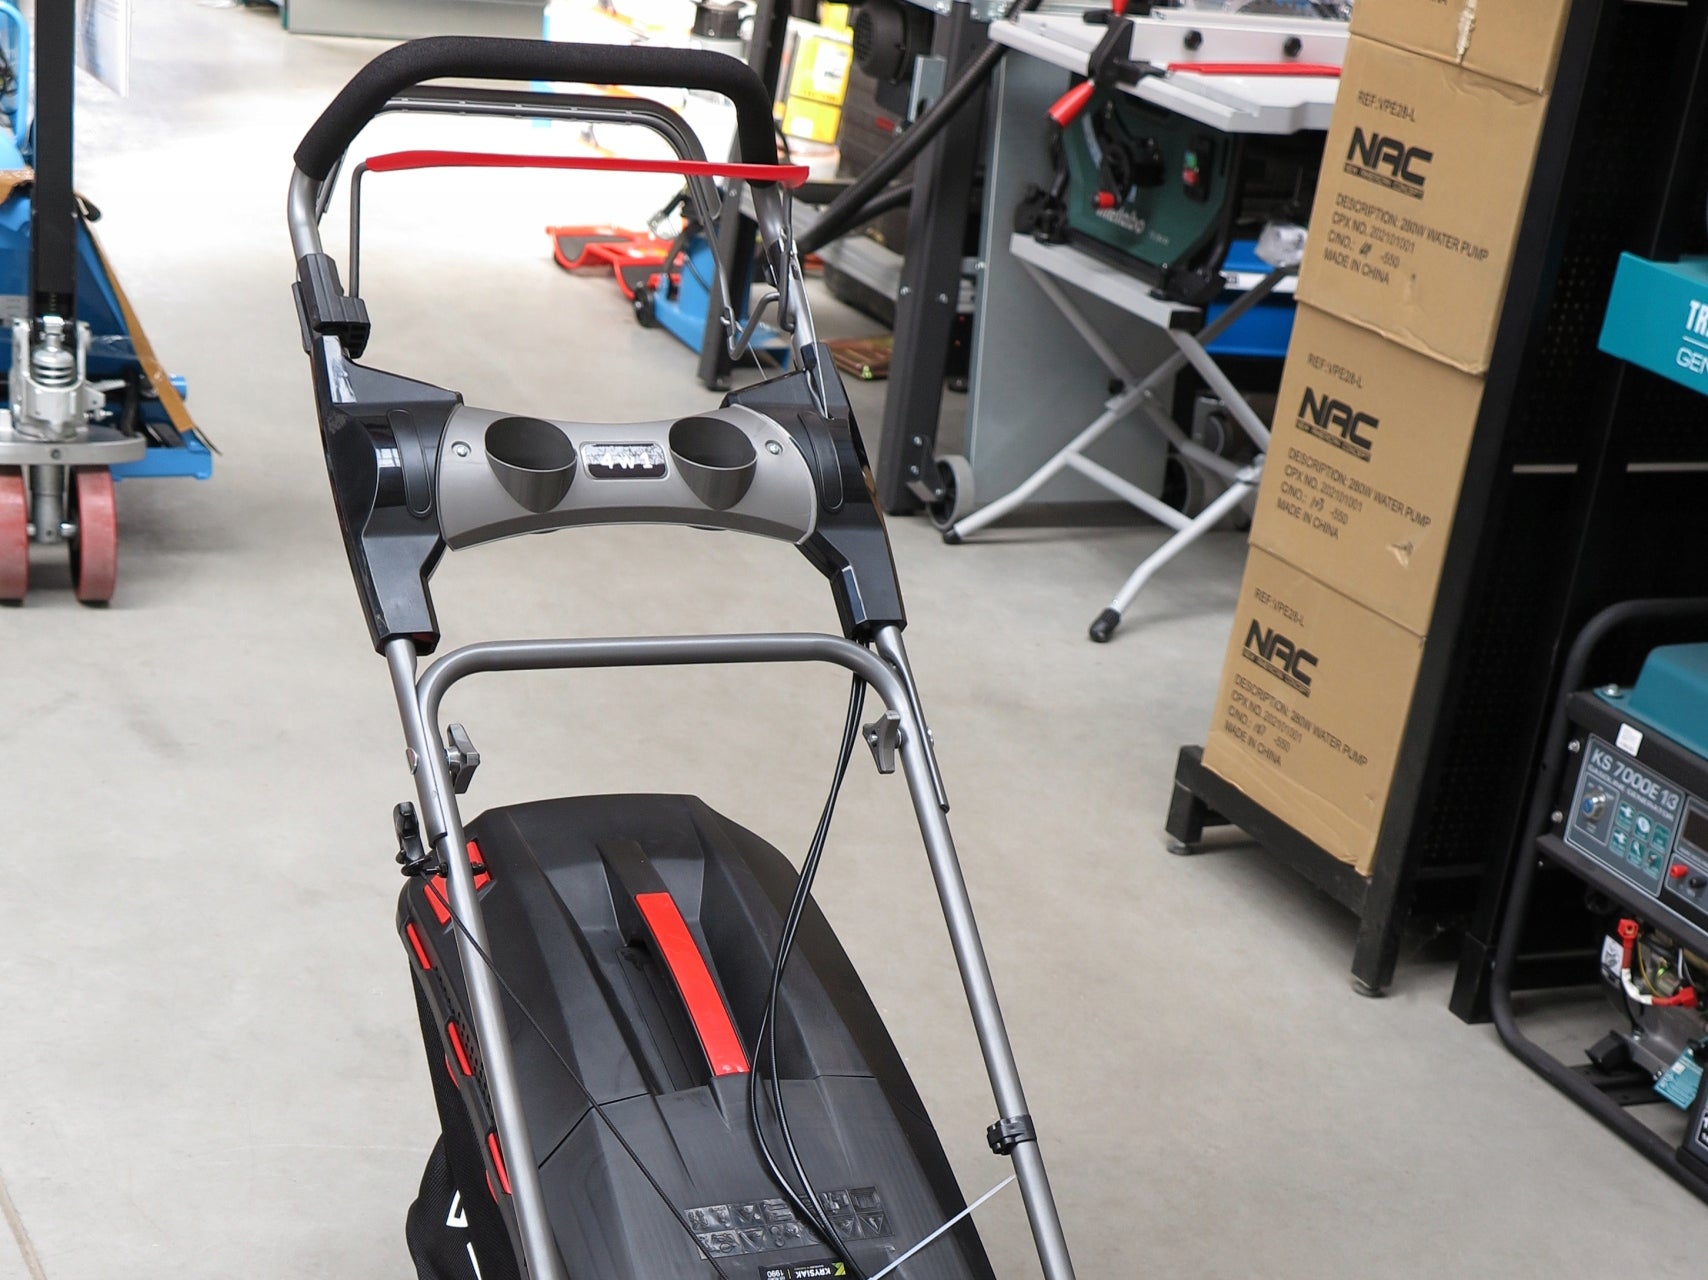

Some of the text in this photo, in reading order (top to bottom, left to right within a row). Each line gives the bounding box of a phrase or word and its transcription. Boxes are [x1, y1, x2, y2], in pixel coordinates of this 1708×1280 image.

[1347, 126, 1433, 186] NAC
[1324, 247, 1349, 269] MADE
[1350, 258, 1360, 273] IN
[1361, 262, 1390, 285] CHINA
[1427, 228, 1460, 251] WATER
[1461, 241, 1489, 262] PUMP
[1299, 386, 1379, 450] NAC
[1288, 447, 1347, 487] DESCRIPTION:
[1374, 489, 1405, 516] WATER
[1405, 505, 1431, 528] PUMP
[1277, 497, 1301, 519] MADE
[1302, 510, 1312, 524] IN
[1312, 517, 1339, 540] CHINA
[1245, 619, 1319, 687] NAC
[1224, 719, 1248, 743] MADE
[1247, 735, 1257, 748] IN
[1257, 742, 1282, 767] CHINA
[1312, 726, 1342, 751] WATER
[1342, 744, 1368, 767] PUMP
[1591, 748, 1613, 771] KS
[1613, 761, 1661, 800] 7000E
[766, 1269, 784, 1278] 1990
[795, 1267, 831, 1279] KRYSIAK
